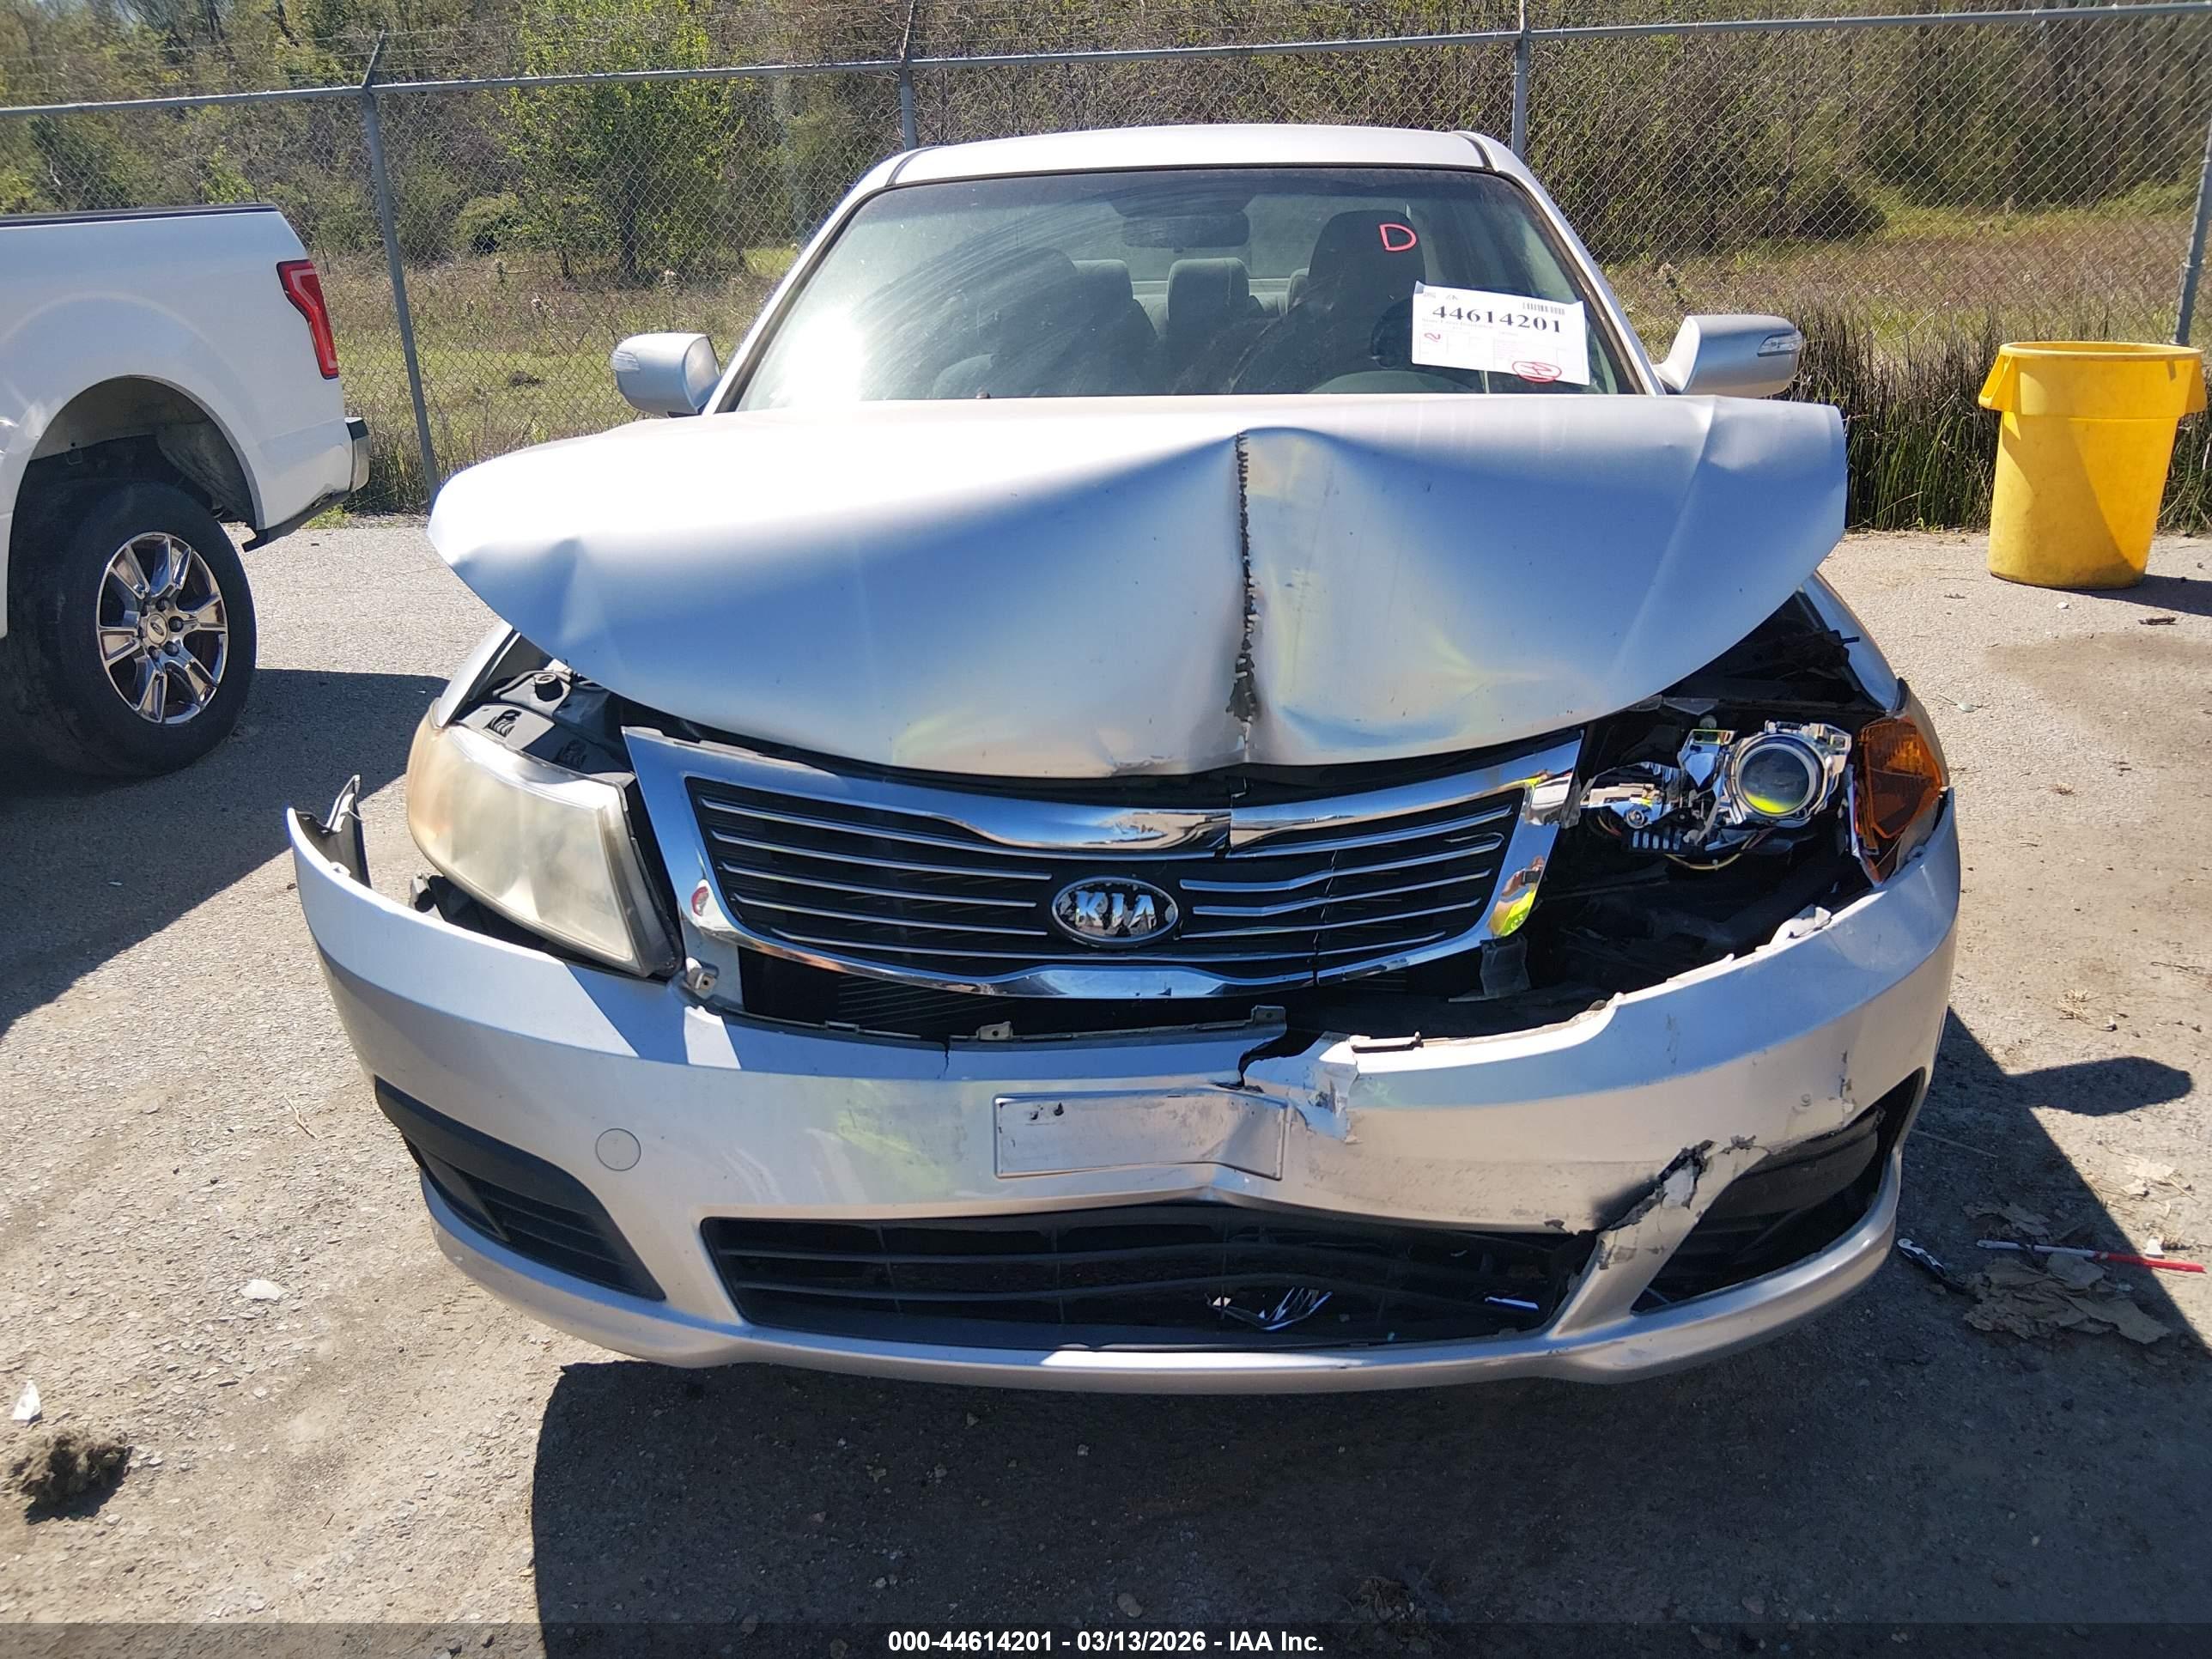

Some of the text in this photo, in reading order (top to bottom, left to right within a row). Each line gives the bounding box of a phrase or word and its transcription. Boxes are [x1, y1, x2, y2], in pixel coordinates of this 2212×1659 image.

[1378, 223, 1417, 251] D
[1431, 305, 1560, 333] 44614201
[1074, 890, 1157, 929] KIA
